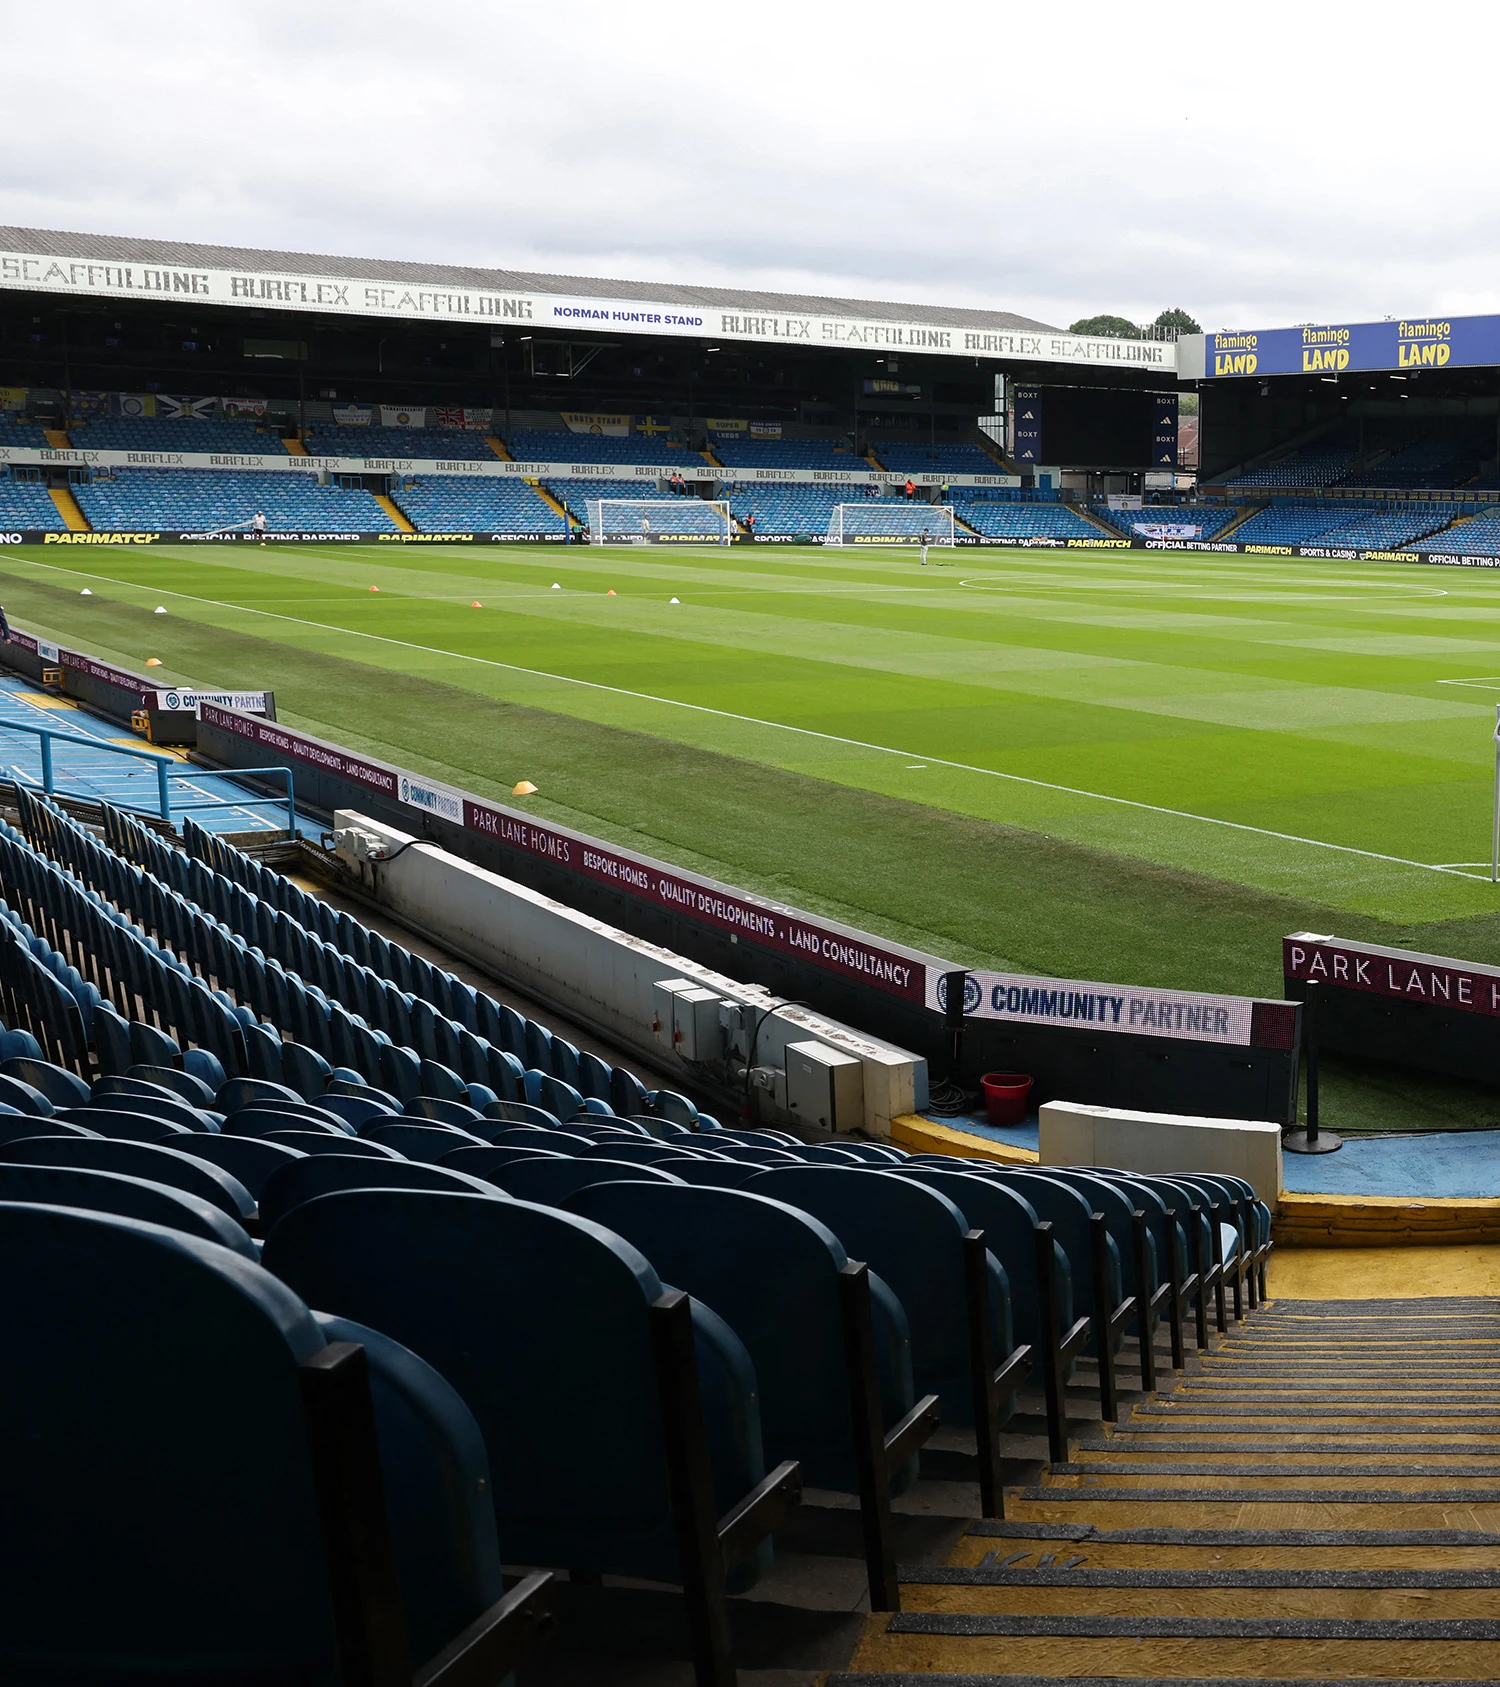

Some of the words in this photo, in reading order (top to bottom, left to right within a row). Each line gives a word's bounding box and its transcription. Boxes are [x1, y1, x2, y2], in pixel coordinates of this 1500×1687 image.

[2, 257, 209, 295] SCAFFOLDING
[231, 276, 349, 306] BURFLEX
[365, 288, 533, 319] SCAFFOLDING
[554, 306, 609, 320] NORMAN
[613, 311, 661, 323] HUNTER
[664, 315, 703, 326] STAND
[722, 315, 810, 338] BURFLEX
[822, 323, 951, 348] SCAFFOLDING
[965, 333, 1040, 355] BURFLEX
[1050, 340, 1162, 363] SCAFFOLDING
[1214, 334, 1258, 352] flamingo
[1302, 326, 1350, 347] flamingo
[1398, 319, 1451, 341] flamingo
[1215, 354, 1257, 376] LAND
[1302, 348, 1350, 372] LAND
[1398, 342, 1451, 367] LAND
[41, 451, 99, 462] BURFLEX
[127, 453, 183, 465] BURFLEX
[210, 455, 264, 467] BURFLEX
[289, 457, 340, 468] BURFLEX
[364, 460, 413, 470] BURFLEX
[436, 461, 483, 472] BURFLEX
[505, 463, 550, 473] BURFLEX
[571, 465, 615, 475] BURFLEX
[697, 468, 737, 478] BURFLEX
[756, 469, 796, 480] BURFLEX
[813, 471, 852, 481] BURFLEX
[868, 473, 905, 483] BURFLEX
[974, 476, 1008, 485] BURFLEX
[44, 533, 160, 544] PARIMATCH
[1067, 539, 1132, 548] PARIMATCH
[1145, 540, 1187, 549] OFFICIAL
[1187, 541, 1211, 551] BETTING
[1211, 543, 1238, 553] PARTNER
[1245, 545, 1292, 555] PARIMATCH
[1299, 547, 1325, 558] SPORTS
[1325, 549, 1331, 558] &
[1332, 549, 1357, 558] CASINO
[1366, 551, 1419, 562] PARIMATCH
[1428, 554, 1461, 565] OFFICIAL
[1462, 556, 1493, 566] BETTING
[205, 707, 219, 724] PARK
[219, 711, 233, 730] LANE
[234, 716, 254, 738] HOMES
[345, 761, 359, 776] LAND
[472, 808, 498, 836] PARK
[501, 818, 527, 845] LANE
[530, 828, 570, 863] HOMES
[583, 850, 618, 881] BESPOKE
[618, 861, 648, 889] HOMES
[659, 880, 696, 914] QUALITY
[697, 892, 775, 938] DEVELOPMENTS
[788, 925, 819, 954] LAND
[822, 938, 911, 987] CONSULTANCY
[1290, 946, 1370, 985] PARK
[1388, 964, 1473, 1005] LANE
[991, 983, 1123, 1024] COMMUNITY
[1129, 998, 1229, 1035] PARTNER
